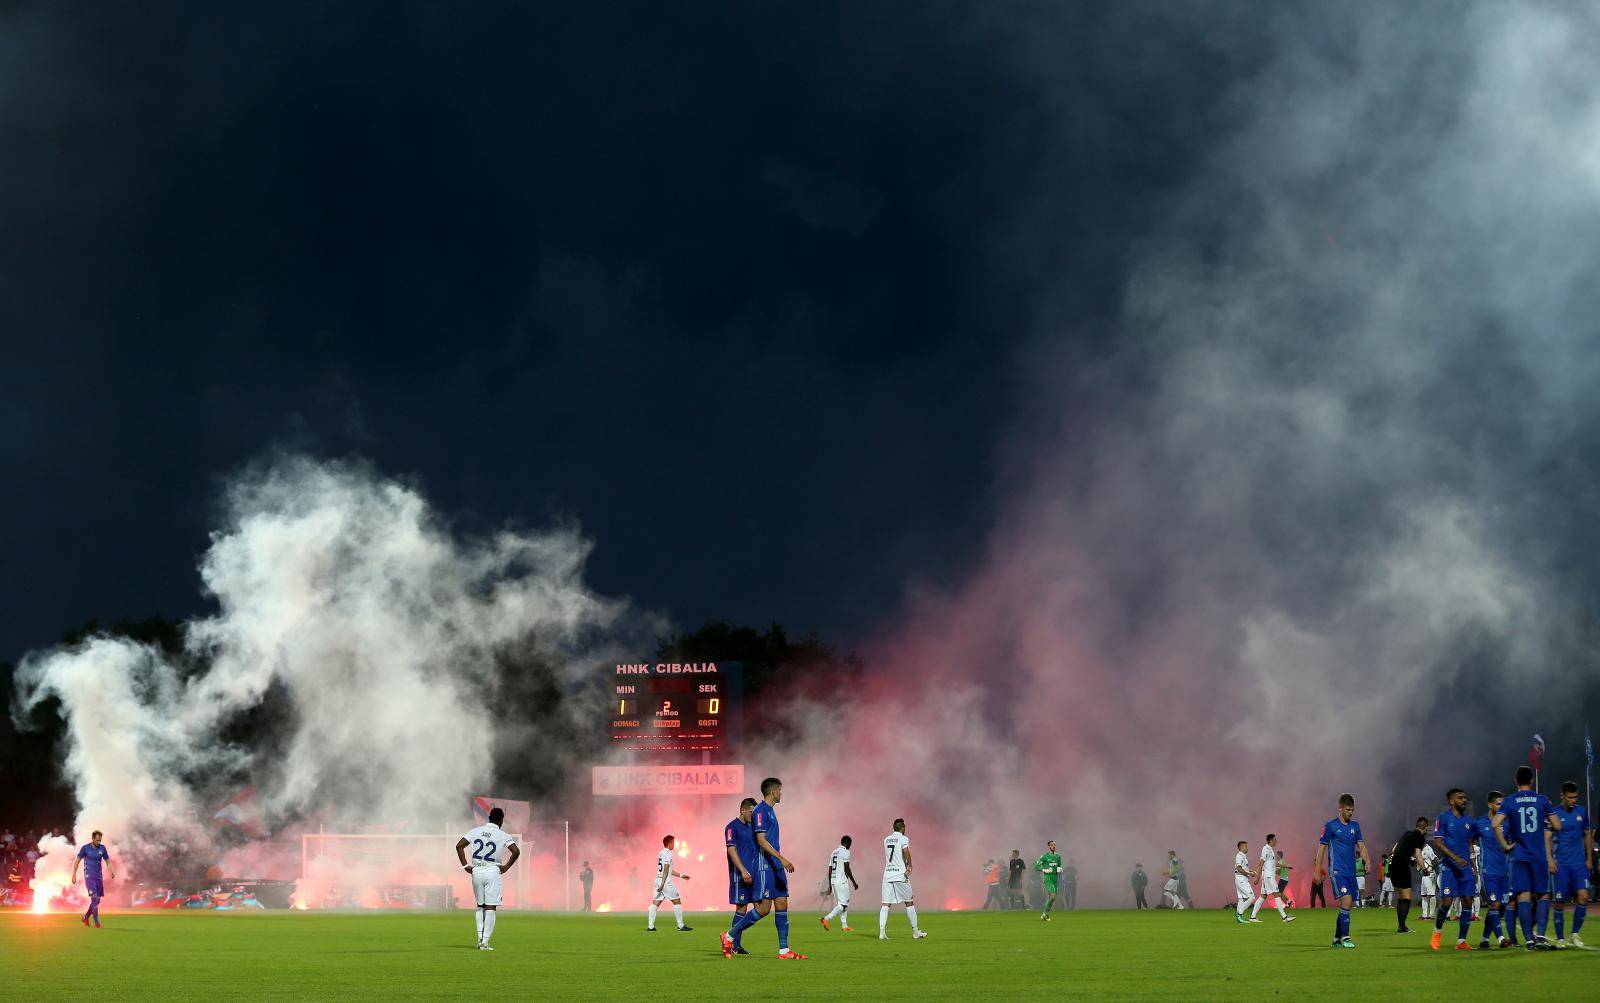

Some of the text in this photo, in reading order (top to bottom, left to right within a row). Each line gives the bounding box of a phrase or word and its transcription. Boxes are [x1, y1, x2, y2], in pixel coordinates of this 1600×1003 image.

[616, 663, 718, 674] HNK CIBALIA
[616, 685, 635, 694] MIN
[699, 684, 717, 693] SEK
[620, 699, 625, 715] 1
[663, 701, 671, 712] 2
[709, 698, 719, 714] 0
[618, 770, 721, 786] HNK CIBALIA
[1517, 806, 1538, 834] 13
[472, 839, 496, 862] 22
[887, 844, 895, 862] 7
